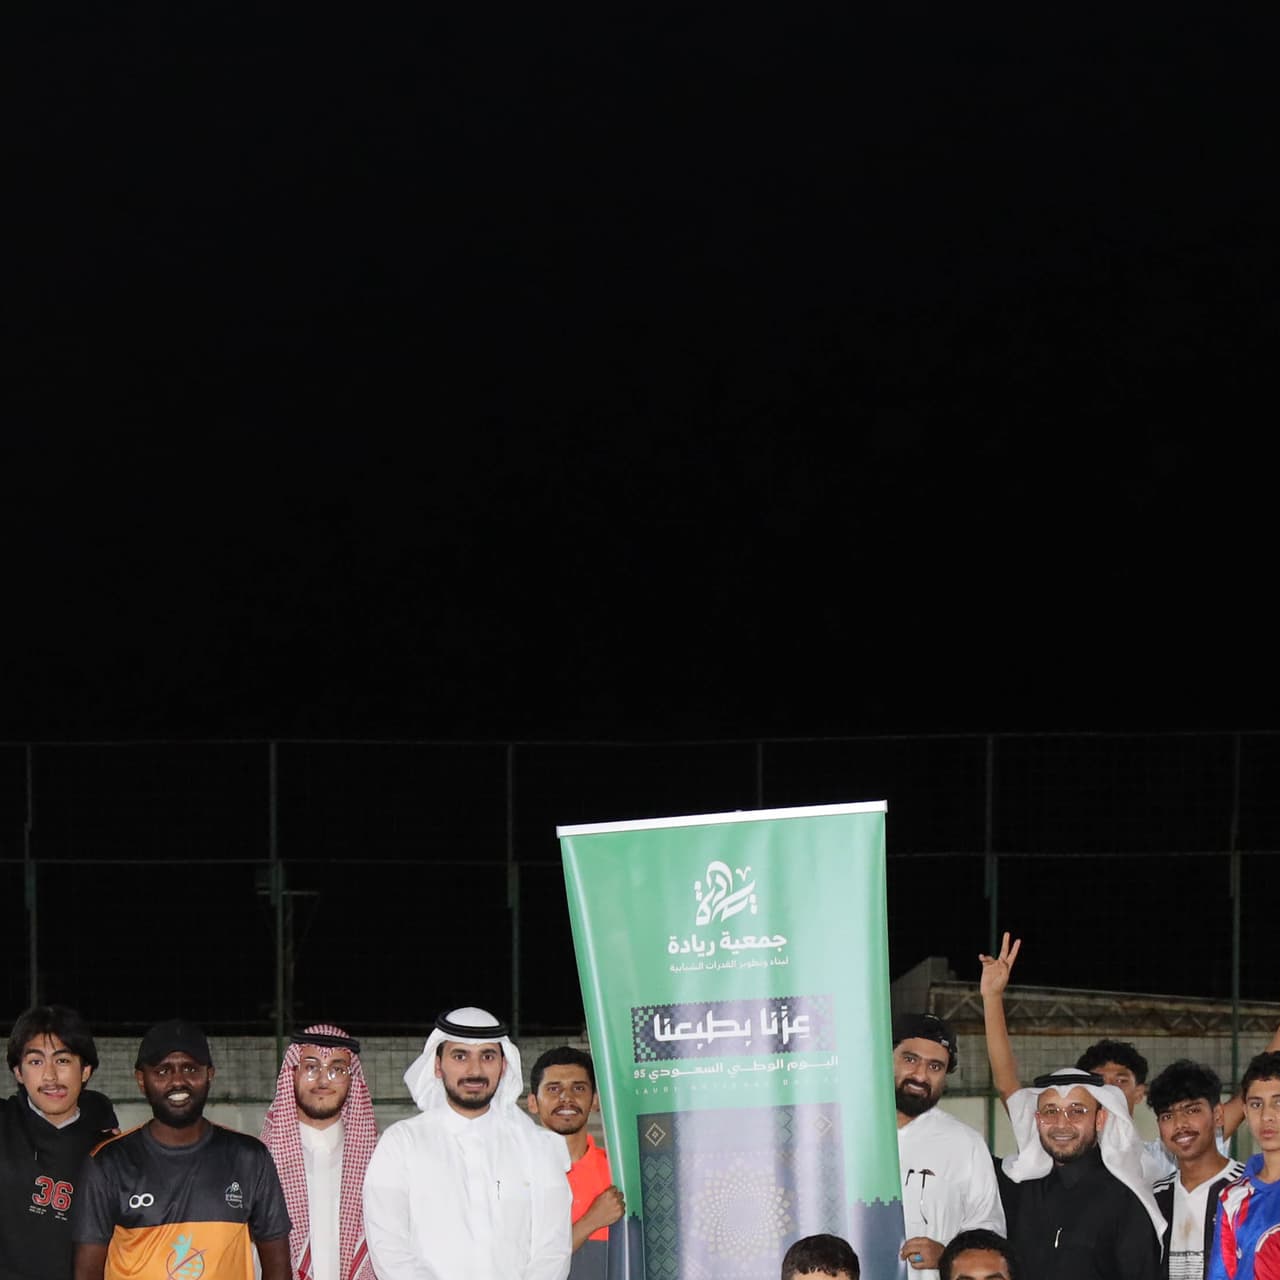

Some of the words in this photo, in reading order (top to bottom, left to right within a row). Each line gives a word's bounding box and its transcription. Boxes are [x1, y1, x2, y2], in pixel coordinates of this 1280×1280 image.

[668, 933, 715, 957] ريادة
[720, 931, 787, 955] جمعية
[653, 1009, 751, 1050] بطبعنا
[32, 1176, 73, 1212] 36
